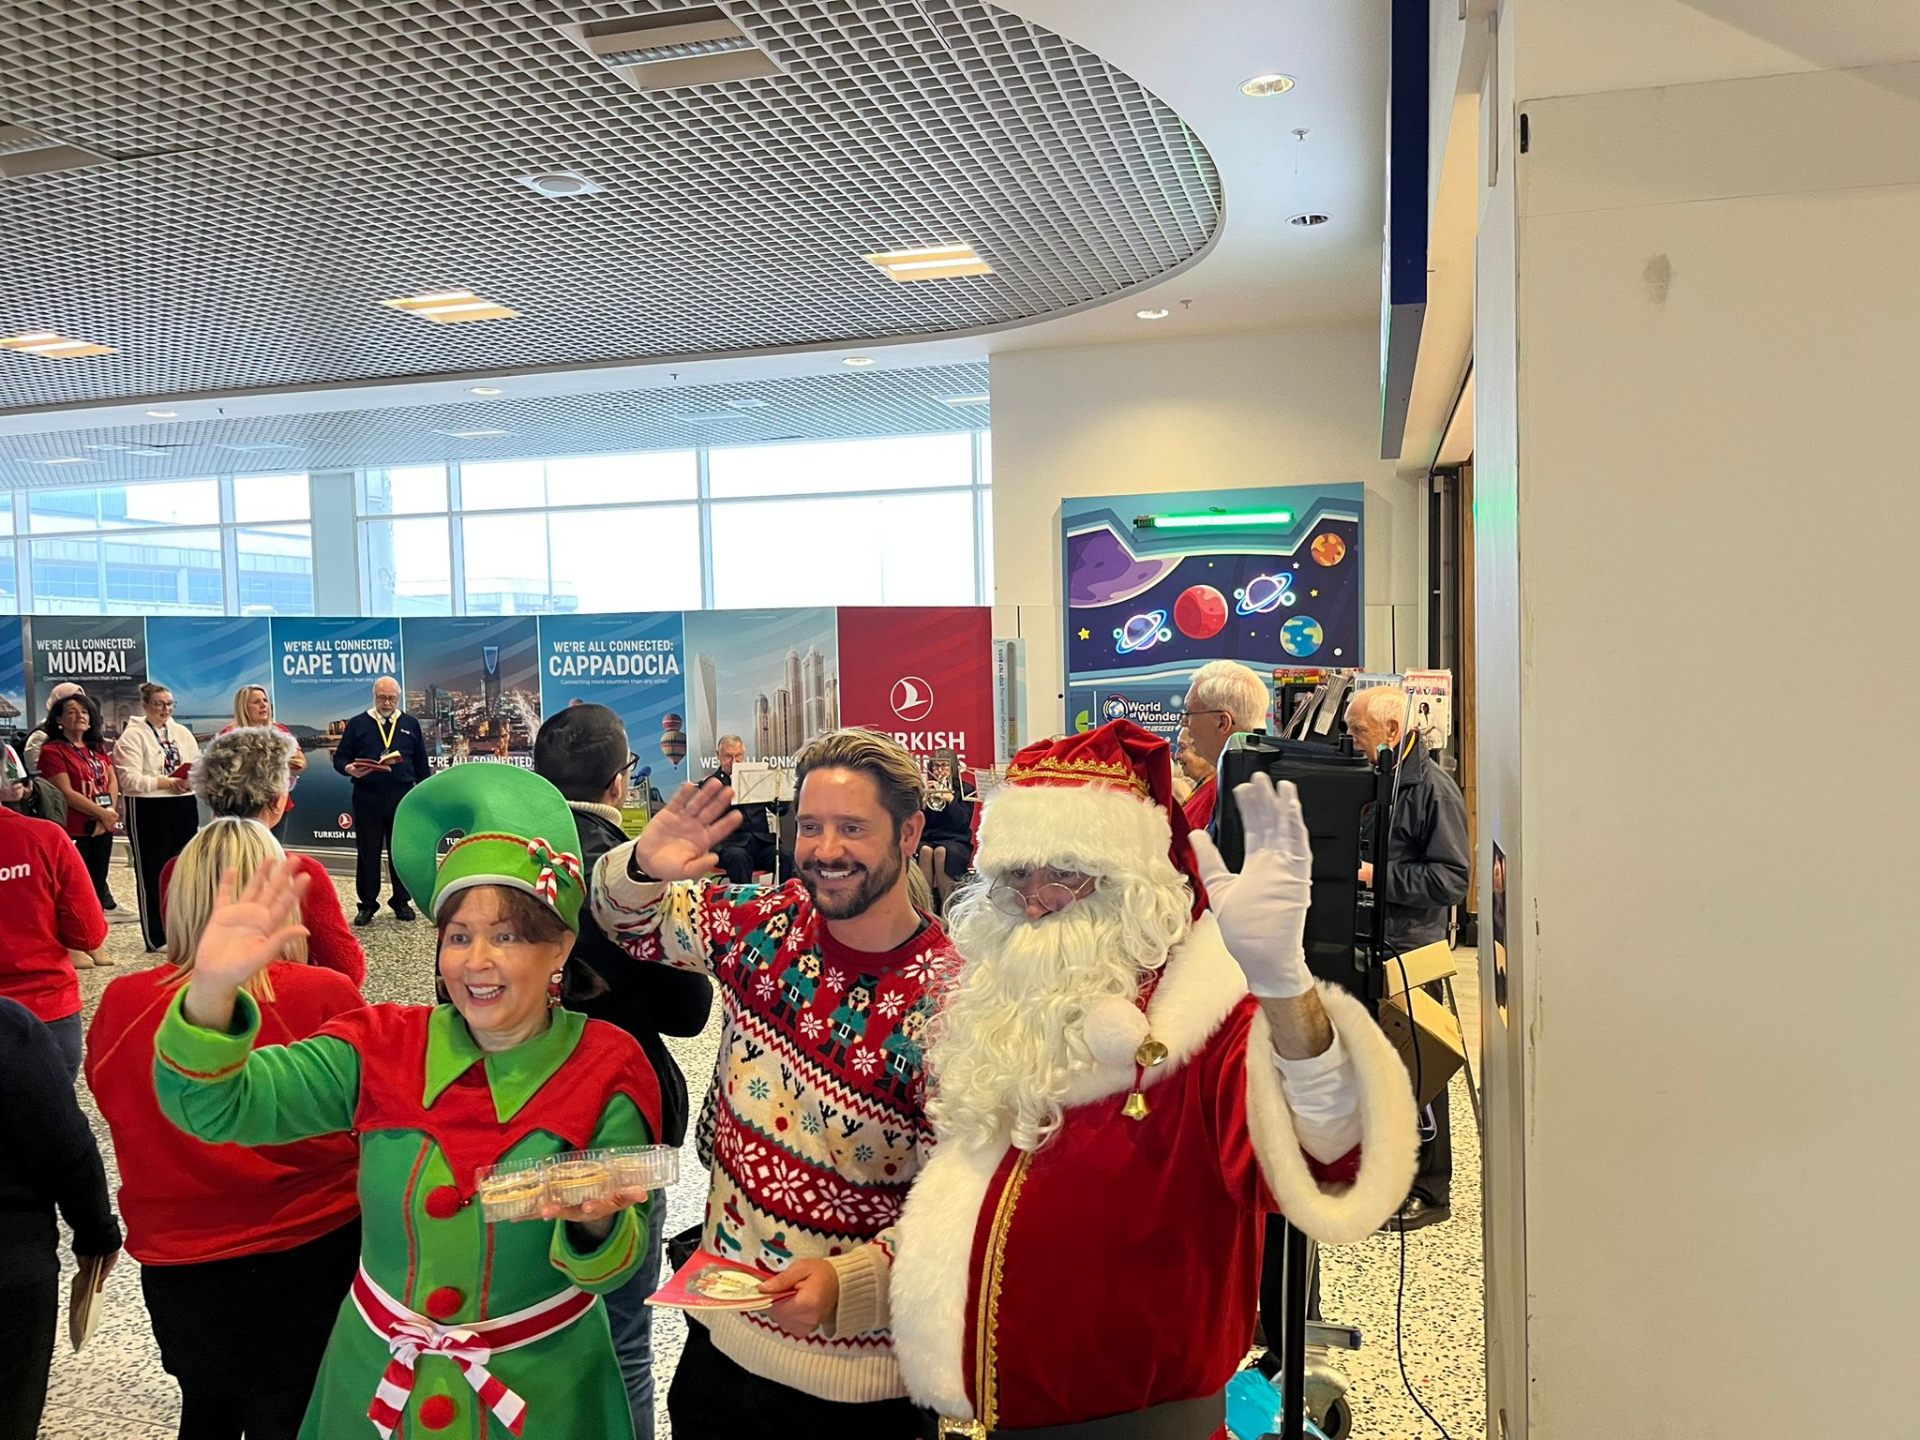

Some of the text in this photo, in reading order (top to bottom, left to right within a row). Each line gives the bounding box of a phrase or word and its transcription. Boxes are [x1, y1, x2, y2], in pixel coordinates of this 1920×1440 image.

[36, 638, 136, 651] WE'RE ALL CONNECTED:
[284, 639, 393, 652] WE'RE ALL CONNECTED:
[553, 640, 674, 653] WE'RE ALL CONNECTED:
[48, 651, 126, 674] MUMBAI
[283, 652, 396, 676] CAPE TOWN
[548, 654, 680, 676] CAPPADOCIA
[1128, 701, 1161, 712] World
[888, 732, 965, 750] RKISH
[428, 756, 450, 768] E'RE
[313, 831, 345, 839] TURKISH
